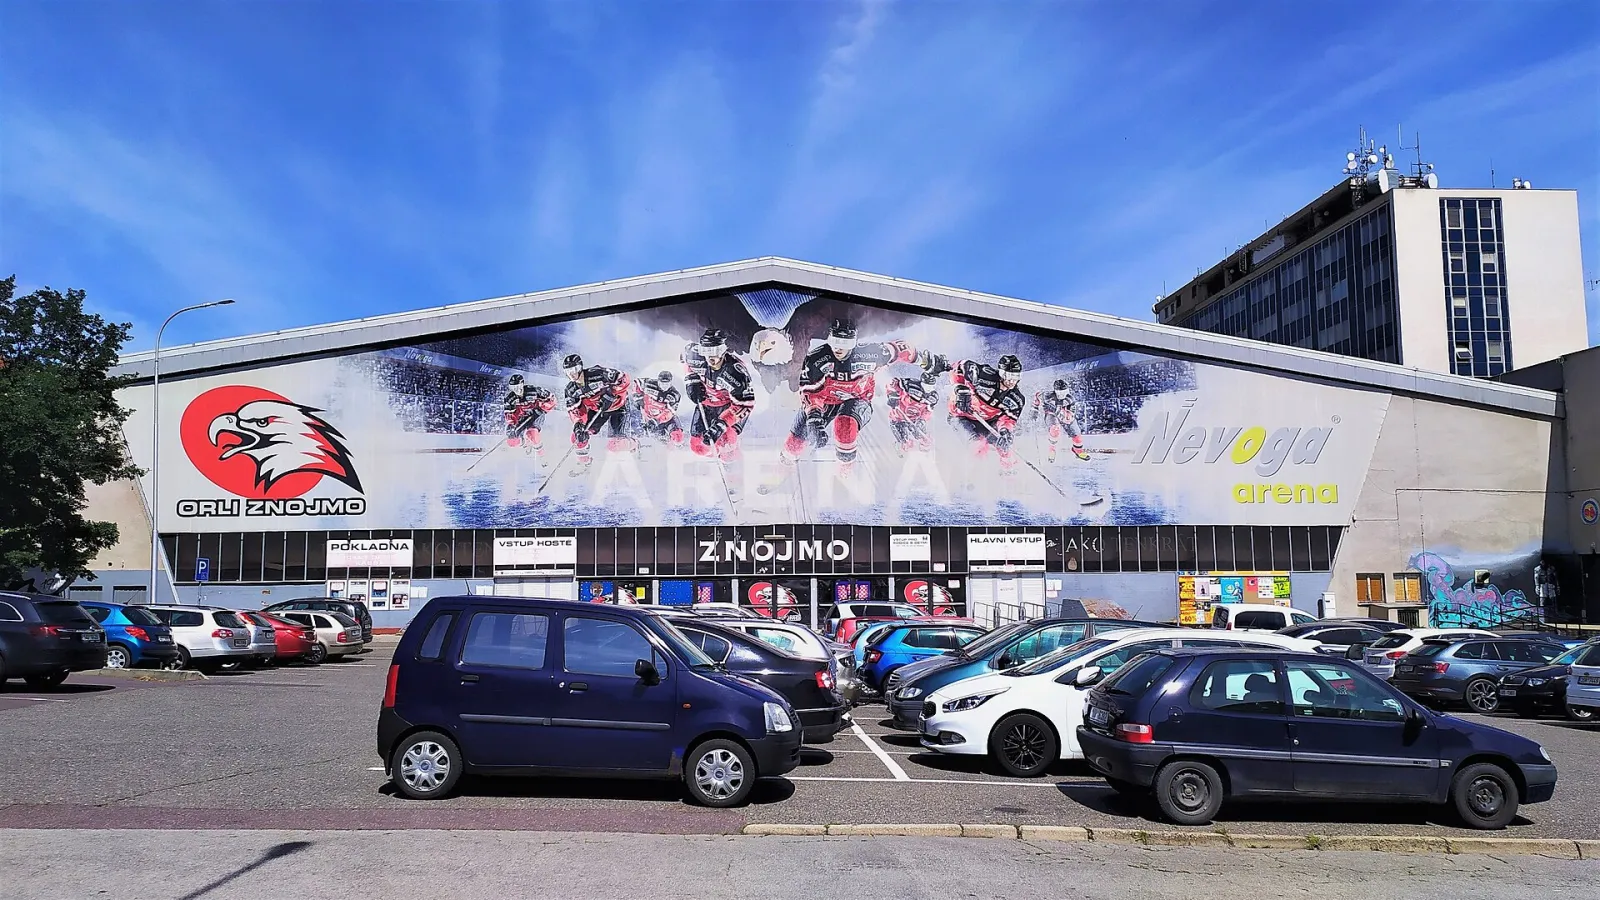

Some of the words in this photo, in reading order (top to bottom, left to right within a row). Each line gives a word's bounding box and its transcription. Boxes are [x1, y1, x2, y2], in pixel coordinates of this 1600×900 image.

[591, 449, 951, 508] ARENA
[1231, 483, 1339, 504] arena
[177, 499, 241, 517] ORLI
[245, 497, 366, 516] ZNOJMO
[331, 543, 409, 551] POKLADNA
[970, 535, 1006, 543] HLAVNÍ
[699, 539, 850, 562] ZNOJMO
